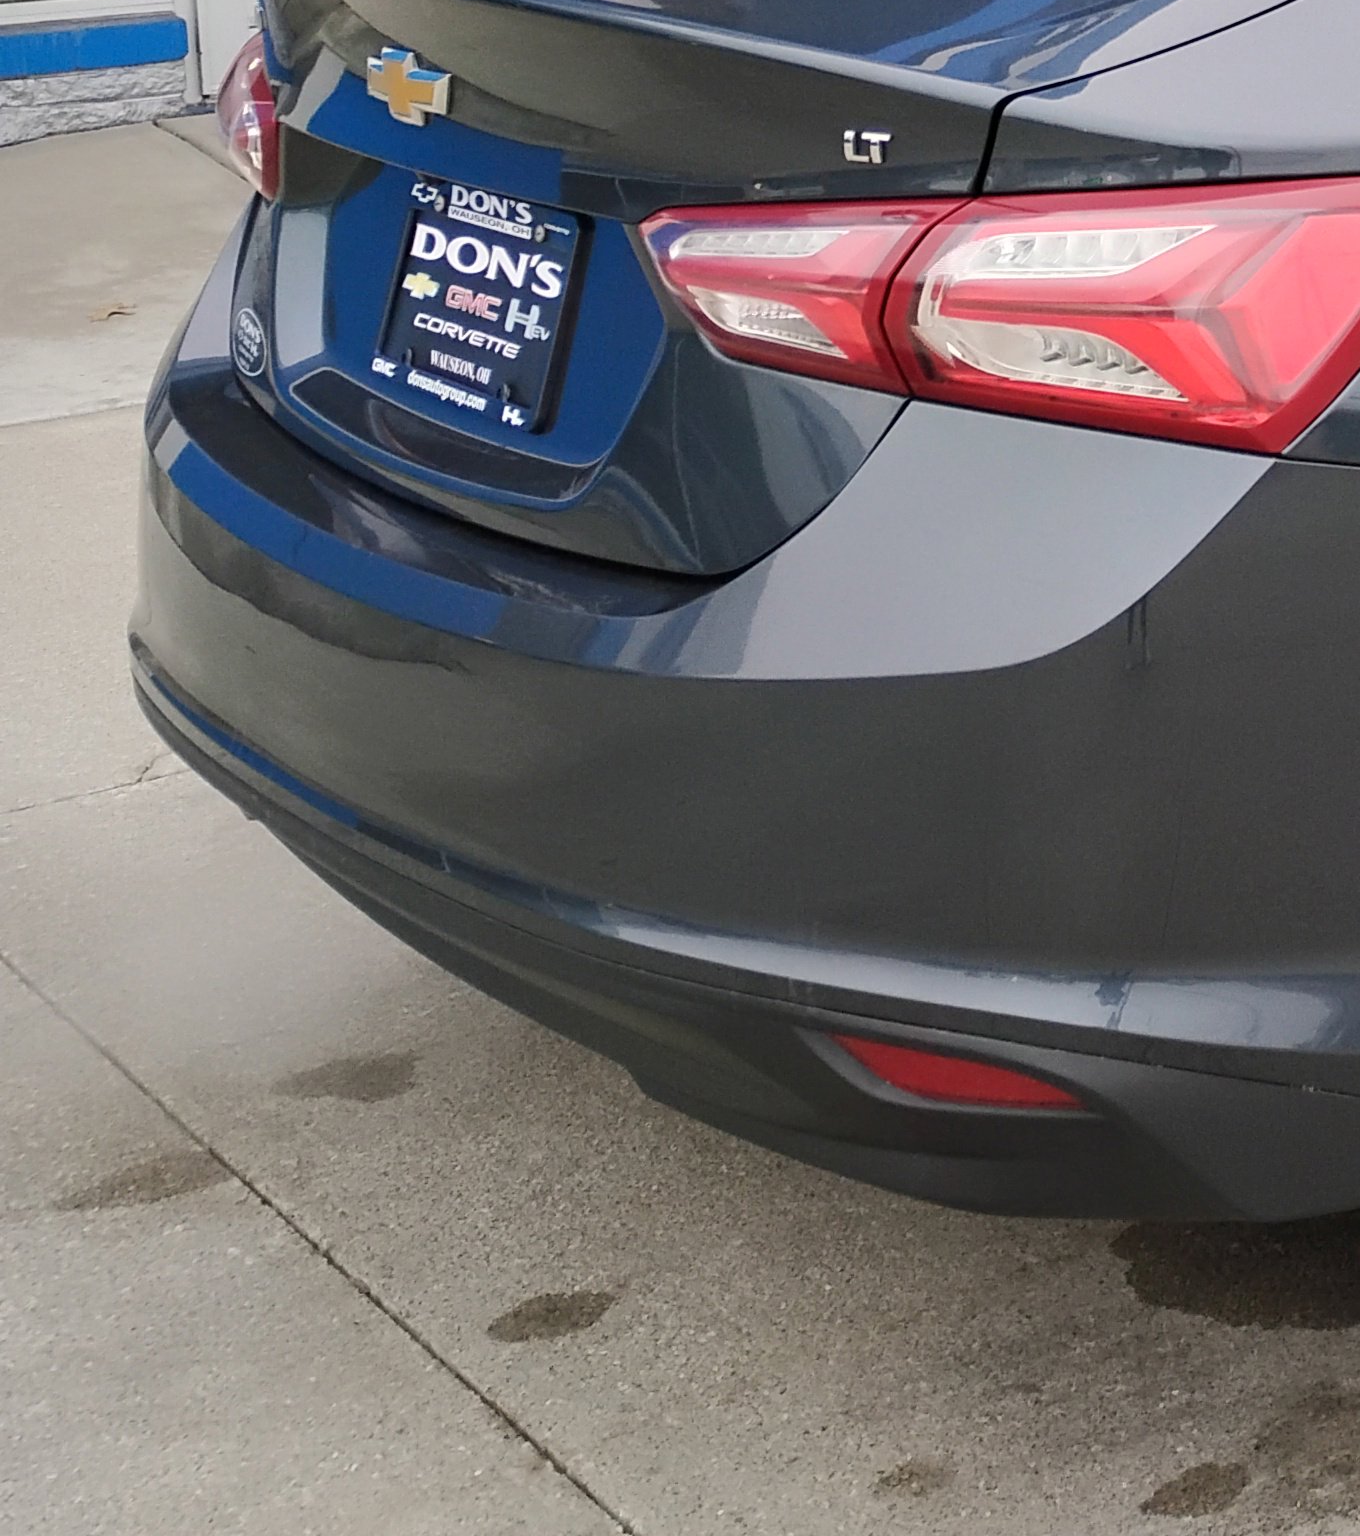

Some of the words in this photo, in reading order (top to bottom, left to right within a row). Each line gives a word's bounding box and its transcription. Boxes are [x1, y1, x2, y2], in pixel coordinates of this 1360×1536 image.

[843, 130, 891, 164] LT
[450, 184, 533, 224] DON'S
[450, 207, 508, 232] WAUSEON,
[511, 225, 530, 237] OH
[410, 223, 563, 299] DON'S
[445, 284, 502, 322] GMC
[413, 312, 522, 360] CORVETTE
[371, 357, 398, 378] GMC
[430, 349, 476, 382] WAUSEON,
[476, 366, 493, 385] OH
[407, 369, 488, 413] donsautogroup.com
